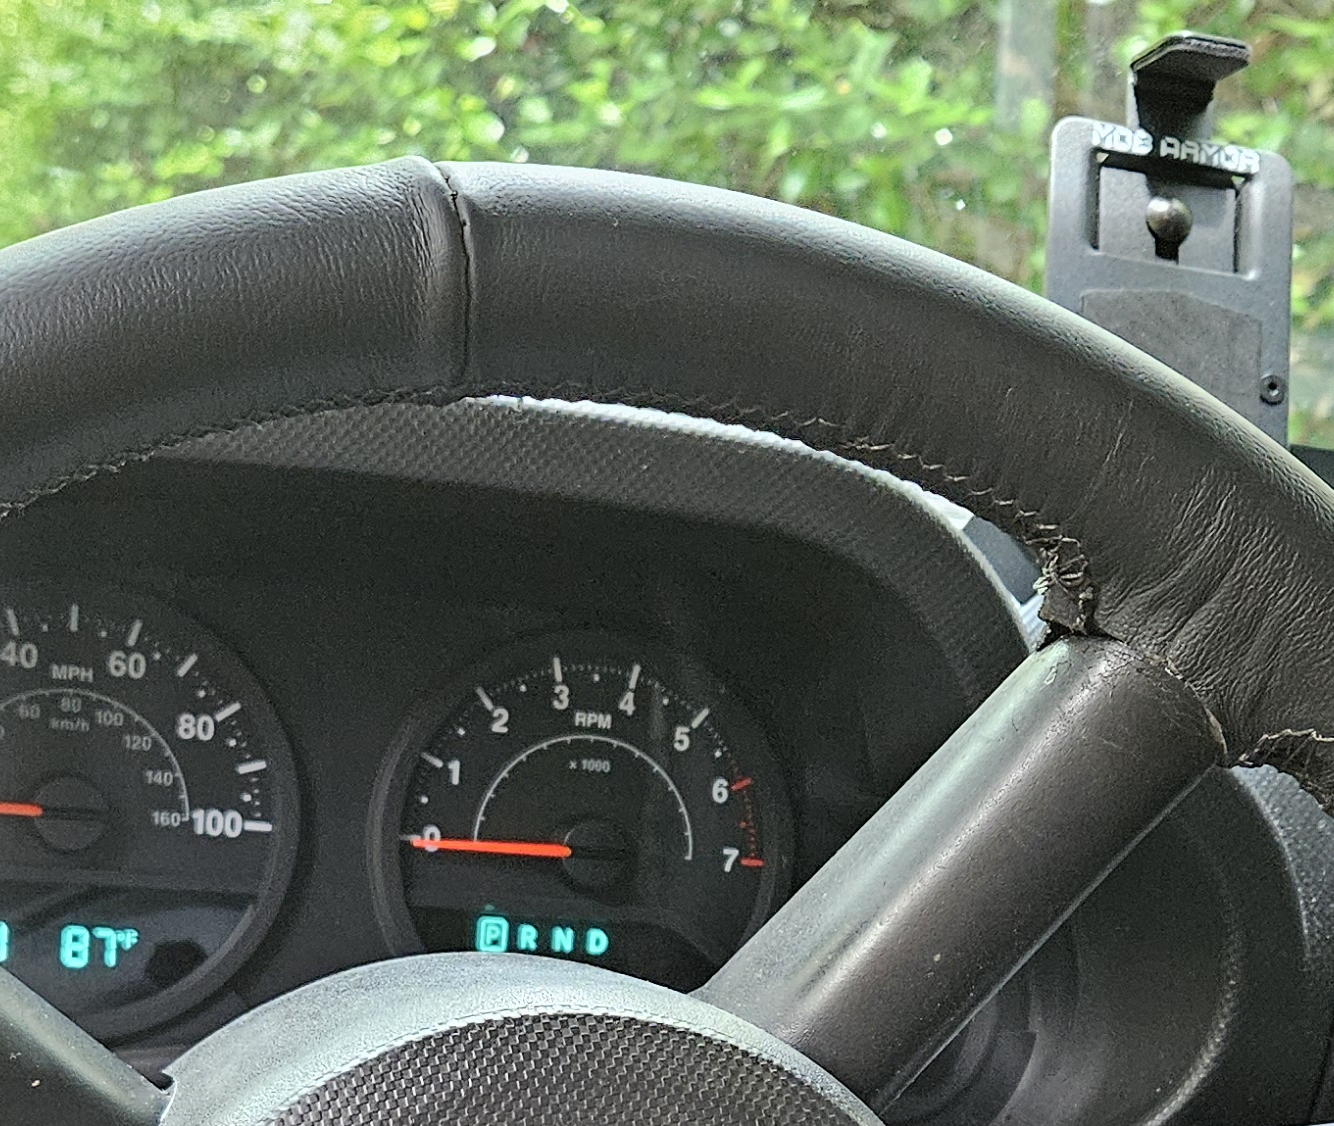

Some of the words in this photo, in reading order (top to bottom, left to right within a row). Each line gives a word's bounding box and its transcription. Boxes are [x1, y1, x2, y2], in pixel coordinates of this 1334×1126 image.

[1091, 123, 1154, 156] MOB
[1159, 136, 1260, 174] ARMOR
[1, 642, 37, 667] 40
[110, 653, 145, 678] 60
[53, 666, 93, 681] MPH
[554, 686, 569, 708] 3
[620, 692, 634, 715] 4
[96, 710, 124, 727] 100
[180, 715, 214, 740] 80
[493, 710, 508, 732] 2
[576, 713, 611, 727] RPM
[124, 735, 152, 750] 120
[675, 728, 688, 751] 5
[450, 761, 459, 784] 1
[583, 760, 609, 771] 1000
[147, 772, 172, 785] 140
[714, 780, 727, 802] 6
[154, 812, 178, 826] 160
[194, 811, 242, 836] 100
[423, 826, 441, 851] 0
[724, 849, 737, 872] 7
[518, 925, 537, 949] R
[553, 928, 574, 951] N
[586, 928, 609, 954] D
